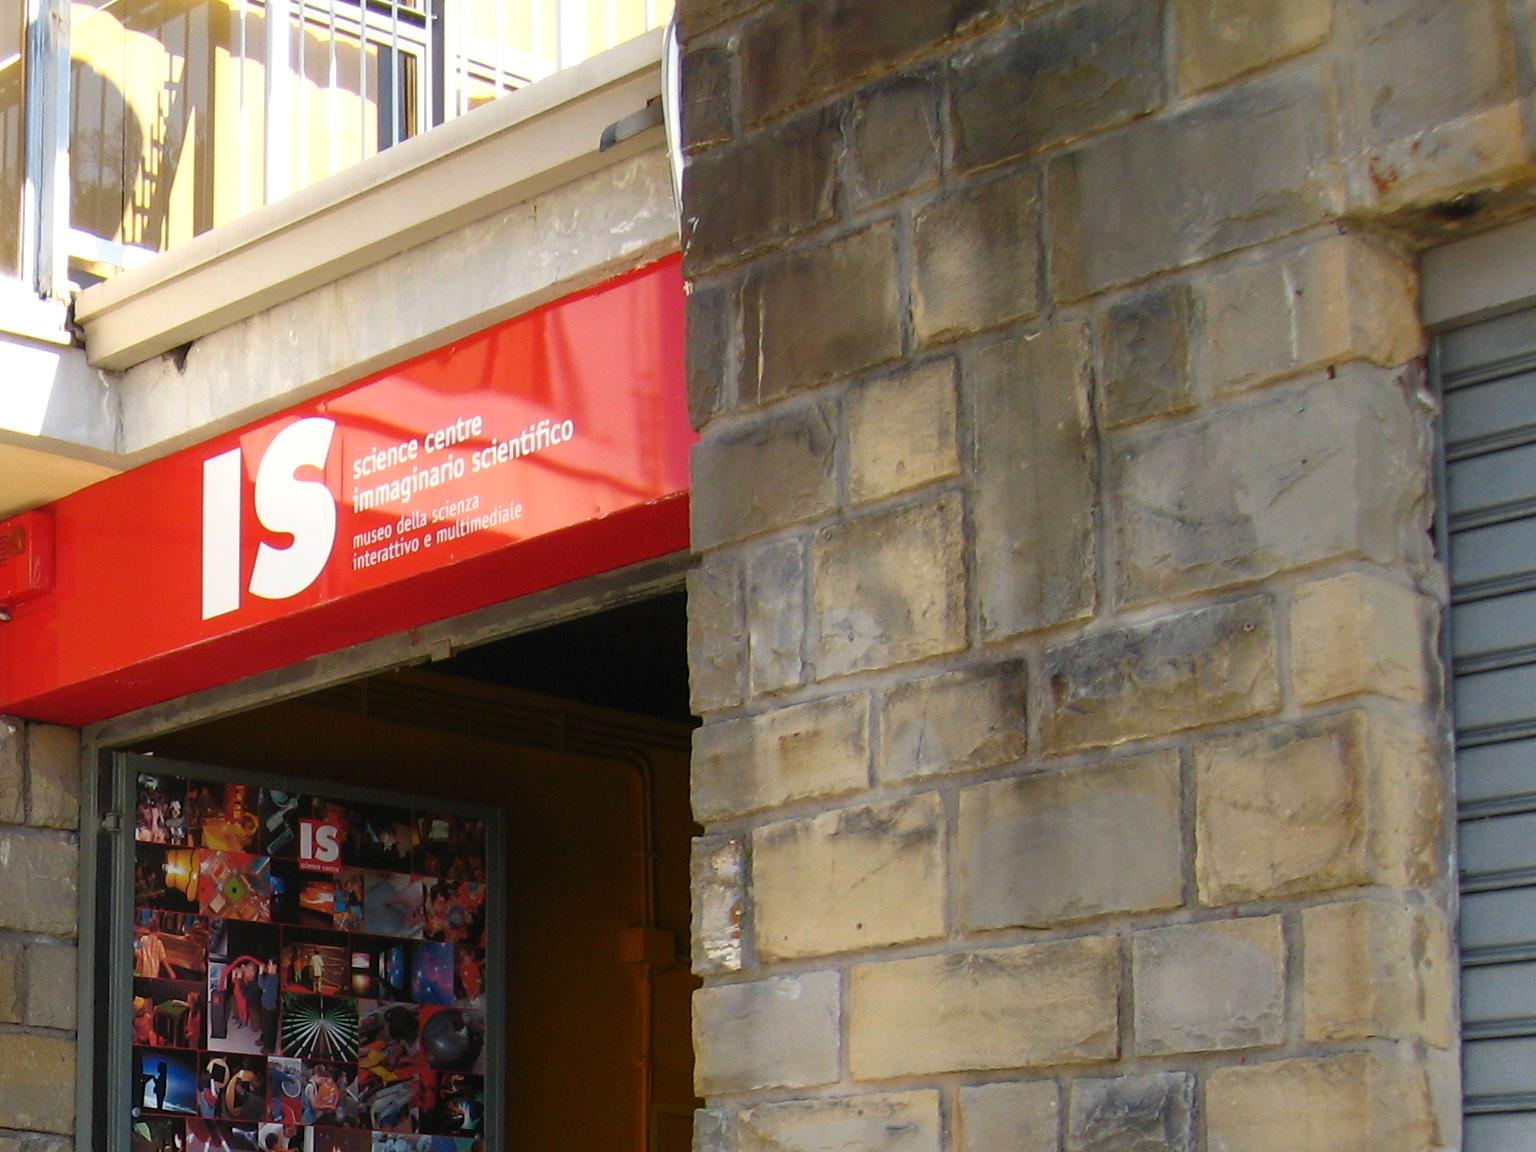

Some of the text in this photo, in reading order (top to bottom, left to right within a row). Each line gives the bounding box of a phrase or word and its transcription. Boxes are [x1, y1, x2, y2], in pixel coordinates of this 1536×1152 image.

[352, 418, 574, 514] immaginario scientifico
[353, 415, 483, 480] science centre
[202, 416, 337, 621] IS
[353, 495, 480, 548] museo della scienza
[353, 503, 523, 570] interattivo e multimediale
[300, 822, 340, 863] IS
